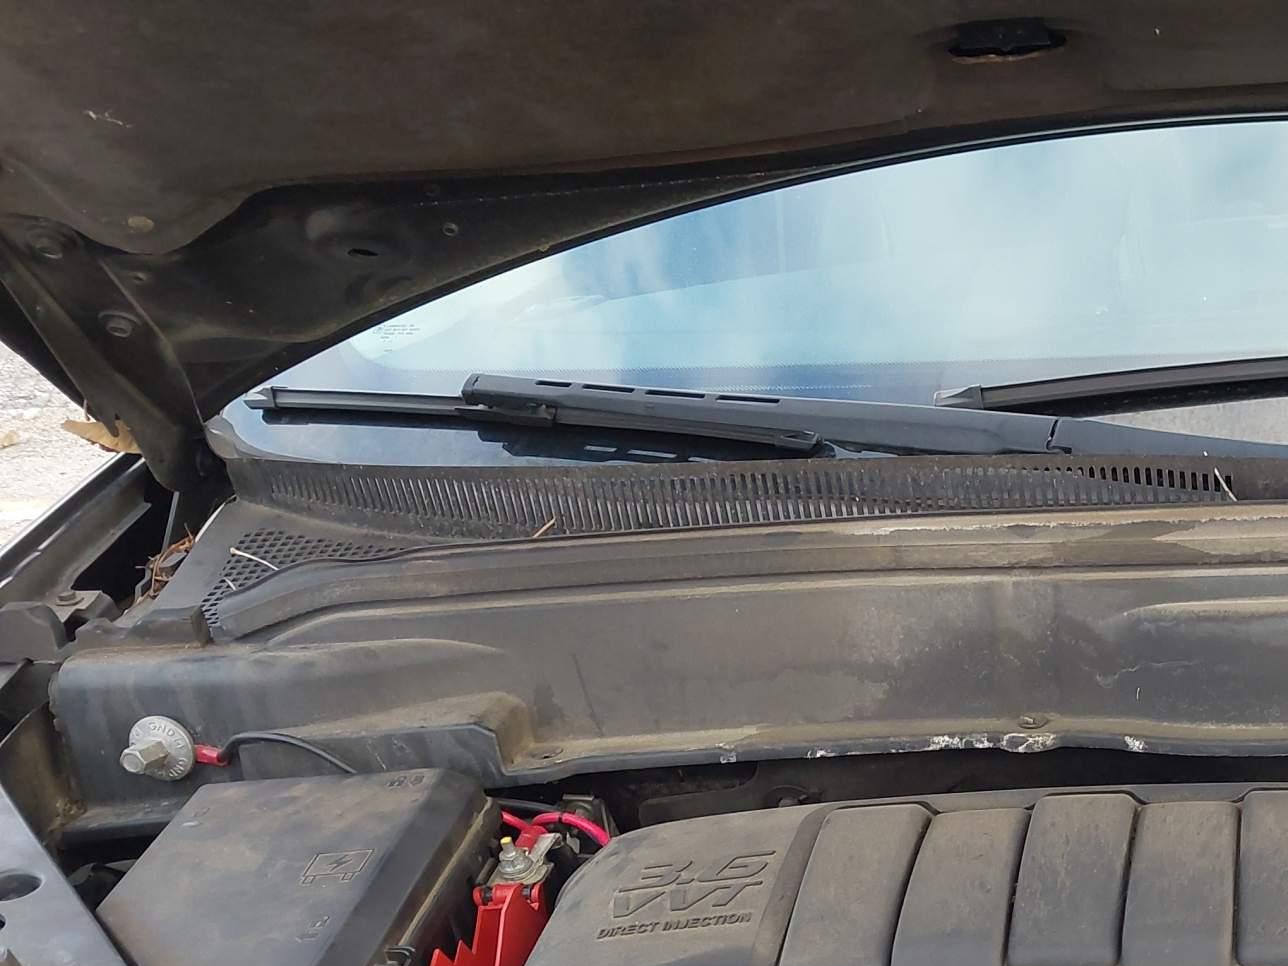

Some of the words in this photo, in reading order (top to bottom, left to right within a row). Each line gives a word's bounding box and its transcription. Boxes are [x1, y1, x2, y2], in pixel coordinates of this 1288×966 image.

[617, 850, 777, 894] 3.6
[612, 880, 764, 919] VVT
[597, 922, 660, 940] DIRECT
[661, 911, 753, 933] INJECTION
